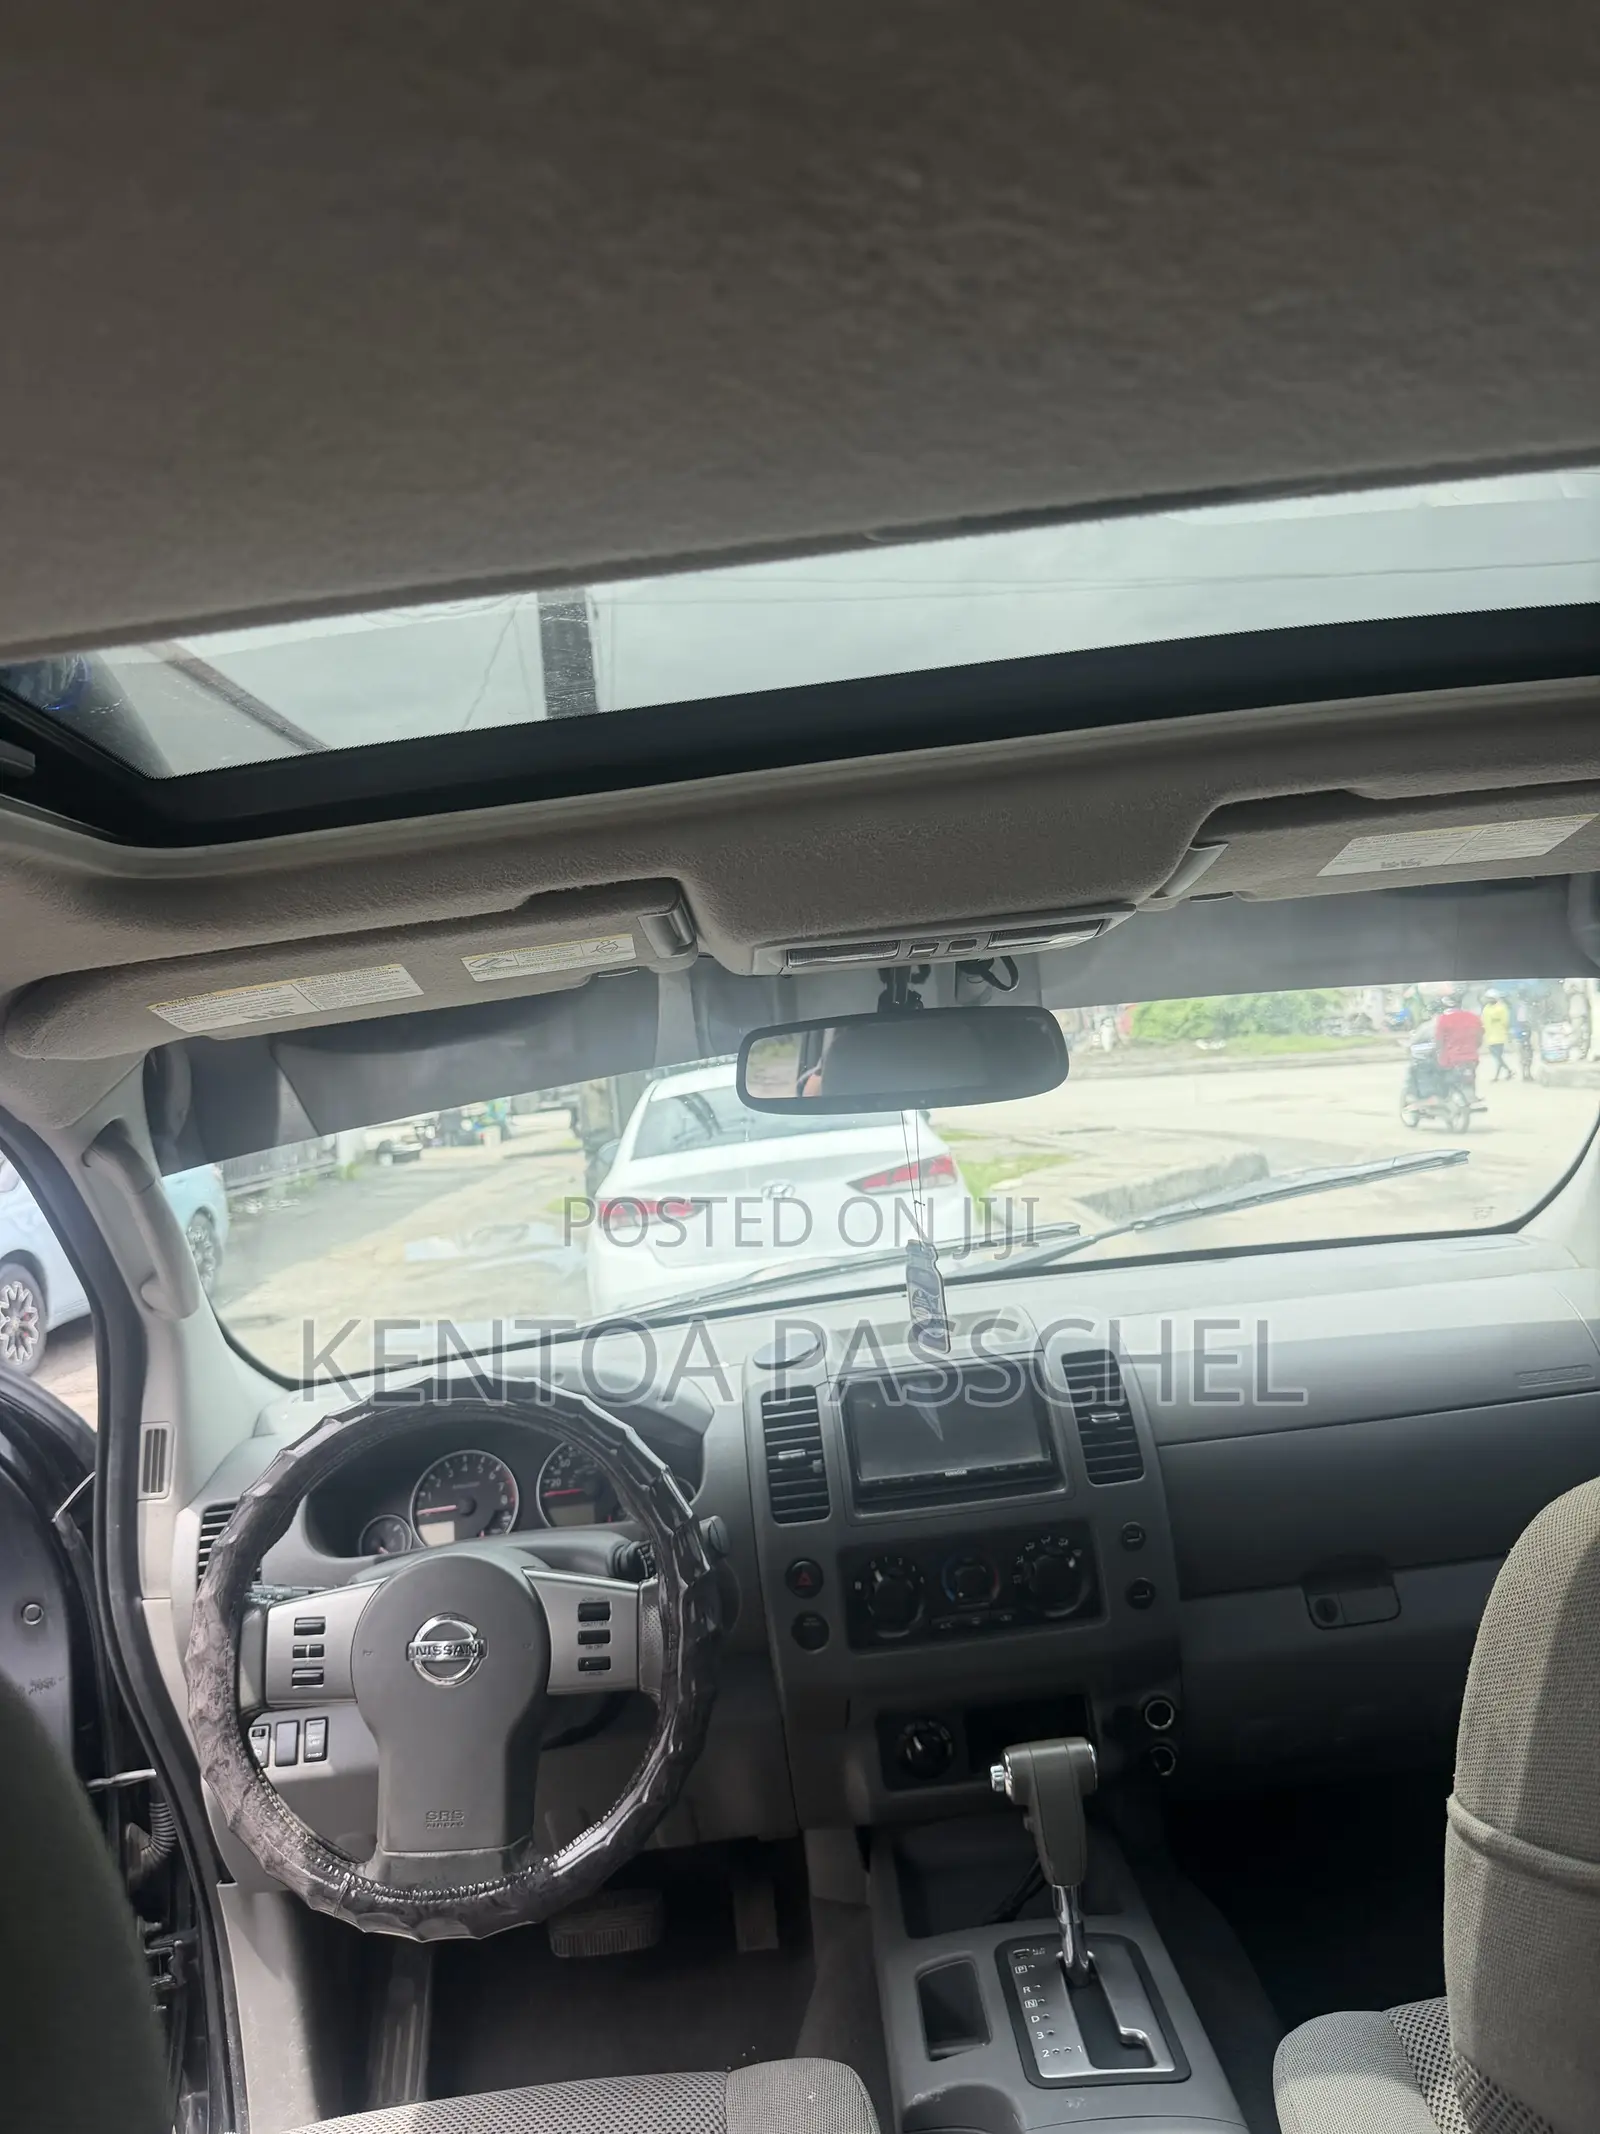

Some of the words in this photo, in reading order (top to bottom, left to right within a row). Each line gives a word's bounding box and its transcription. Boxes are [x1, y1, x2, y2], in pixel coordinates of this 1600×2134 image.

[415, 1641, 479, 1656] NISSAN
[425, 1809, 465, 1822] SRS
[1023, 1986, 1031, 1994] R
[1031, 2015, 1040, 2023] D
[1036, 2031, 1044, 2040] 3
[1042, 2049, 1050, 2058] 2
[1077, 2045, 1082, 2053] 1
